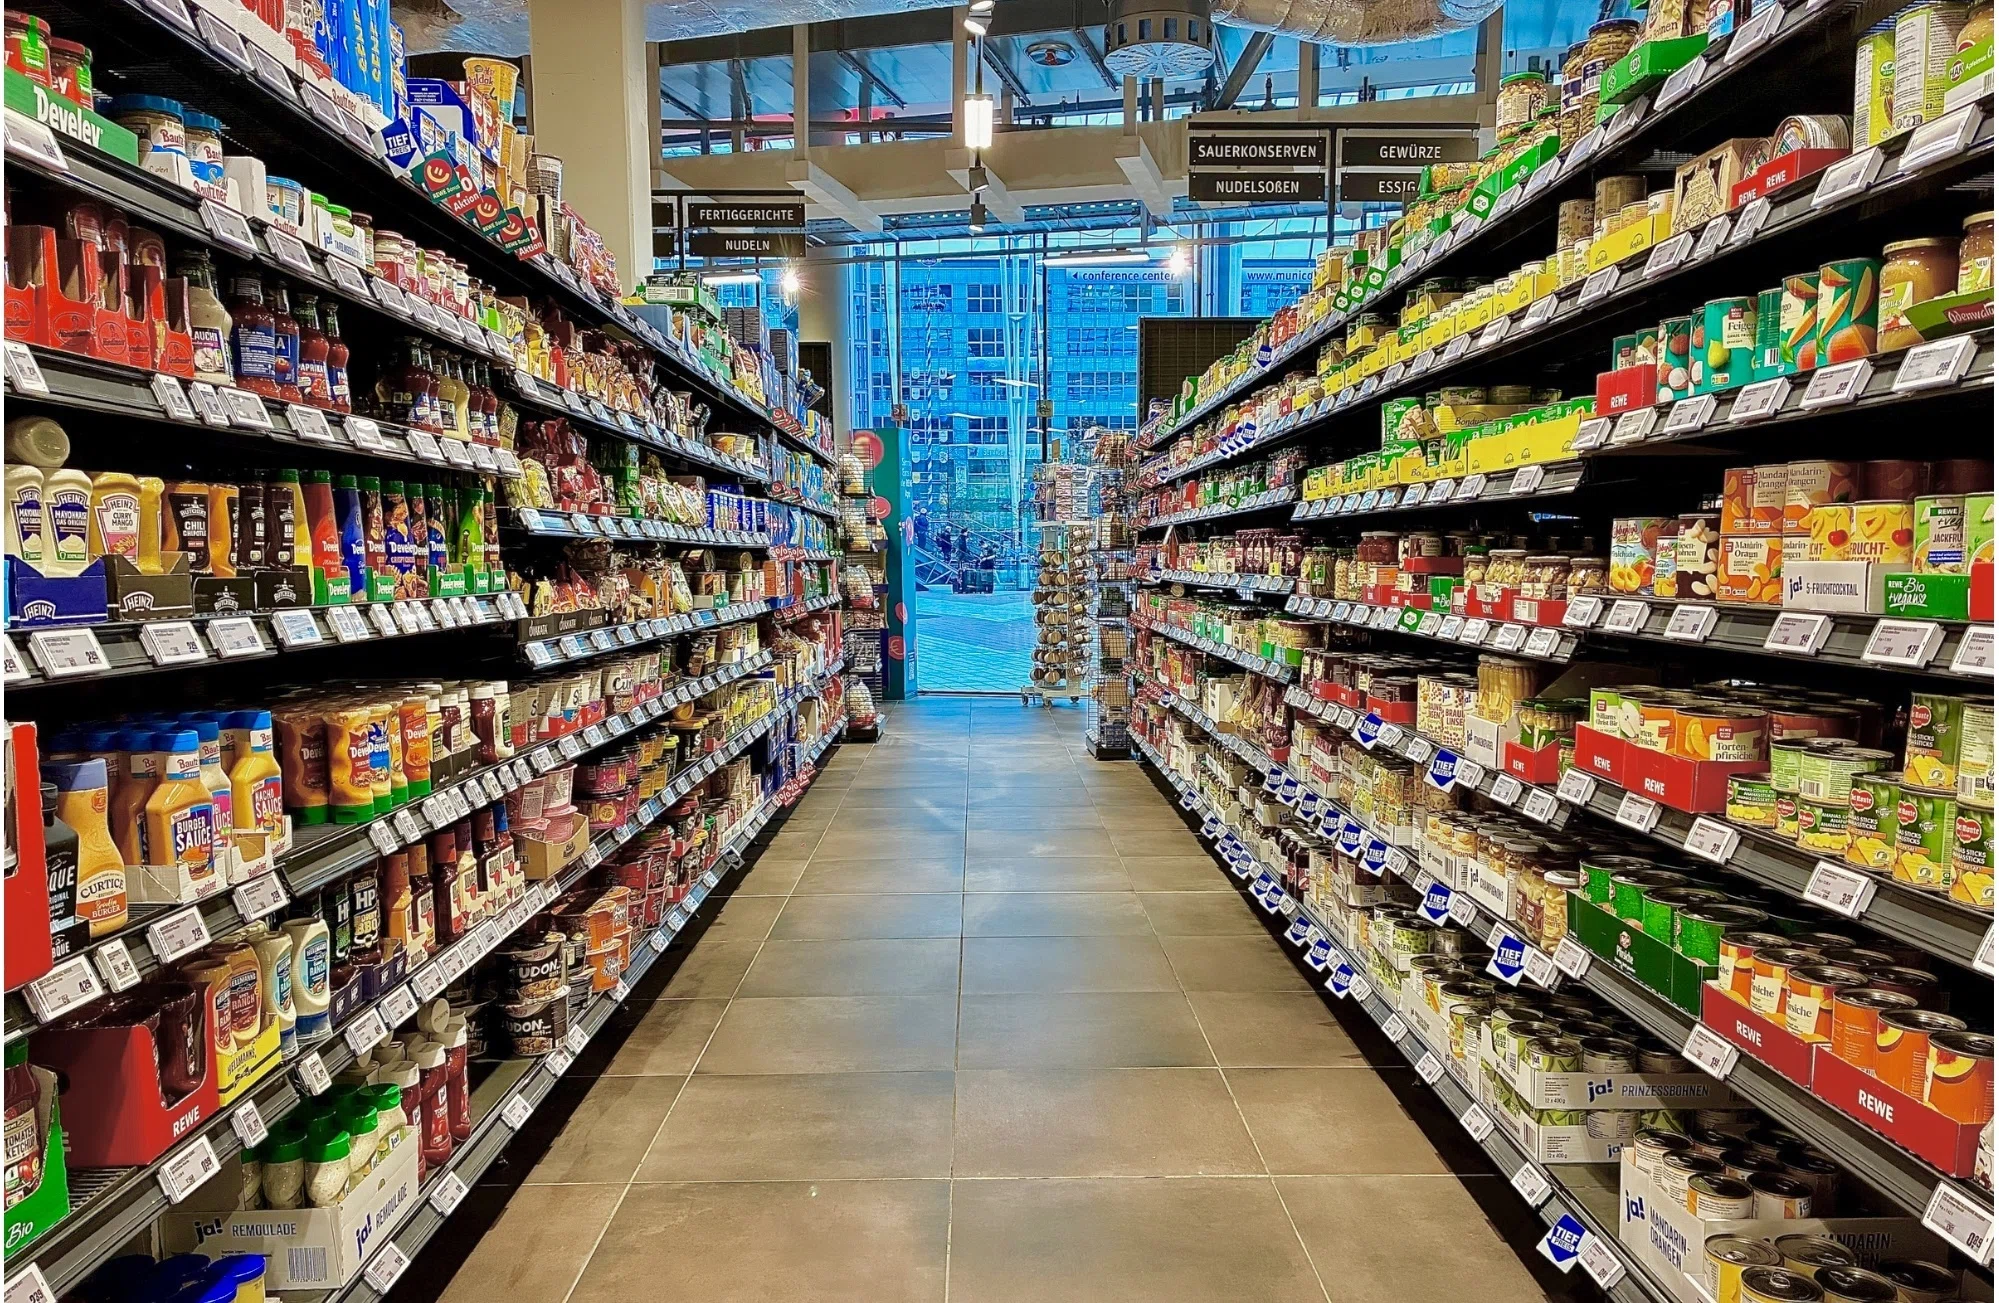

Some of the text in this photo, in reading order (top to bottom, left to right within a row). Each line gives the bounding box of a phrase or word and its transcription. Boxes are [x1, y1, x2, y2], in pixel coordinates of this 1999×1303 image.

[1965, 55, 1987, 71] Apfelmus
[33, 85, 102, 149] Develey
[386, 133, 409, 148] TIEF
[391, 145, 410, 156] PREIS
[1198, 145, 1317, 158] SAUERKONSERVEN
[1379, 145, 1442, 159] GEWÜRZE
[1766, 170, 1787, 189] REWE
[453, 193, 480, 211] Aktion
[1738, 188, 1757, 207] REWE
[700, 209, 794, 221] FERTIGGERICHTE
[323, 231, 333, 249] ja!
[725, 239, 770, 251] NUDELN
[518, 241, 543, 256] Aktion
[1082, 270, 1175, 281] conference center
[1728, 321, 1757, 333] Feigen
[1610, 394, 1628, 408] REWE
[110, 499, 135, 511] HEINZ
[1937, 507, 1958, 515] REWE
[111, 519, 134, 528] MANGO
[112, 511, 132, 522] CURRY
[183, 521, 206, 532] CHILI
[328, 582, 350, 597] Develey
[376, 582, 395, 595] Develey
[1788, 576, 1859, 600] ja! 5-FRUCHTCOCKTAIL
[1887, 577, 1926, 593] REWE Bio
[126, 596, 152, 610] HEINZ
[27, 603, 53, 619] HEINZ
[1364, 716, 1380, 728] TIEF
[1716, 741, 1749, 751] Torten-
[1594, 755, 1612, 772] REWE
[1715, 751, 1754, 761] pfirsiche
[1436, 759, 1454, 770] TIEF
[1513, 759, 1525, 773] REWE
[1434, 768, 1452, 778] PREIS
[1644, 778, 1666, 796] REWE
[255, 787, 275, 803] NACHO
[254, 796, 283, 820] SAUCE
[176, 815, 206, 834] BURGER
[1859, 815, 1878, 825] STICKS
[1344, 831, 1359, 839] TIEF
[1963, 825, 1981, 835] Monte
[175, 827, 212, 852] SAUCE
[1369, 848, 1385, 857] TIEF
[1966, 850, 1987, 860] STICKS
[1470, 868, 1479, 887] ja!
[80, 877, 125, 899] CURTICE
[355, 888, 376, 910] HP
[1429, 893, 1447, 904] TIEF
[92, 904, 122, 919] BURGER
[1315, 946, 1329, 956] TIEF
[1500, 947, 1522, 959] TIEF
[518, 959, 558, 980] UDON
[1498, 957, 1519, 968] PREIS
[381, 970, 390, 984] HP
[1336, 970, 1350, 982] TIEF
[232, 994, 256, 1010] RANCH
[336, 998, 343, 1013] HP
[506, 1018, 545, 1034] UDON
[1736, 1020, 1762, 1048] REWE
[1588, 1078, 1614, 1103] ja!
[1621, 1085, 1710, 1097] PRINZESSBOHNEN
[1859, 1089, 1894, 1123] REWE
[173, 1105, 200, 1137] REWE
[4, 1126, 35, 1147] TOMATEN
[391, 1133, 400, 1148] ja!
[6, 1138, 36, 1160] KETCHUP
[1625, 1189, 1646, 1223] ja!
[355, 1181, 408, 1261] ja! REMOULADE
[6, 1221, 33, 1249] Bio
[194, 1218, 297, 1244] ja! REMOULADE
[1555, 1226, 1580, 1243] TIEF
[1650, 1206, 1692, 1256] MANDARIN-
[1554, 1238, 1574, 1251] PREIS
[1650, 1225, 1683, 1272] ORANGEN
